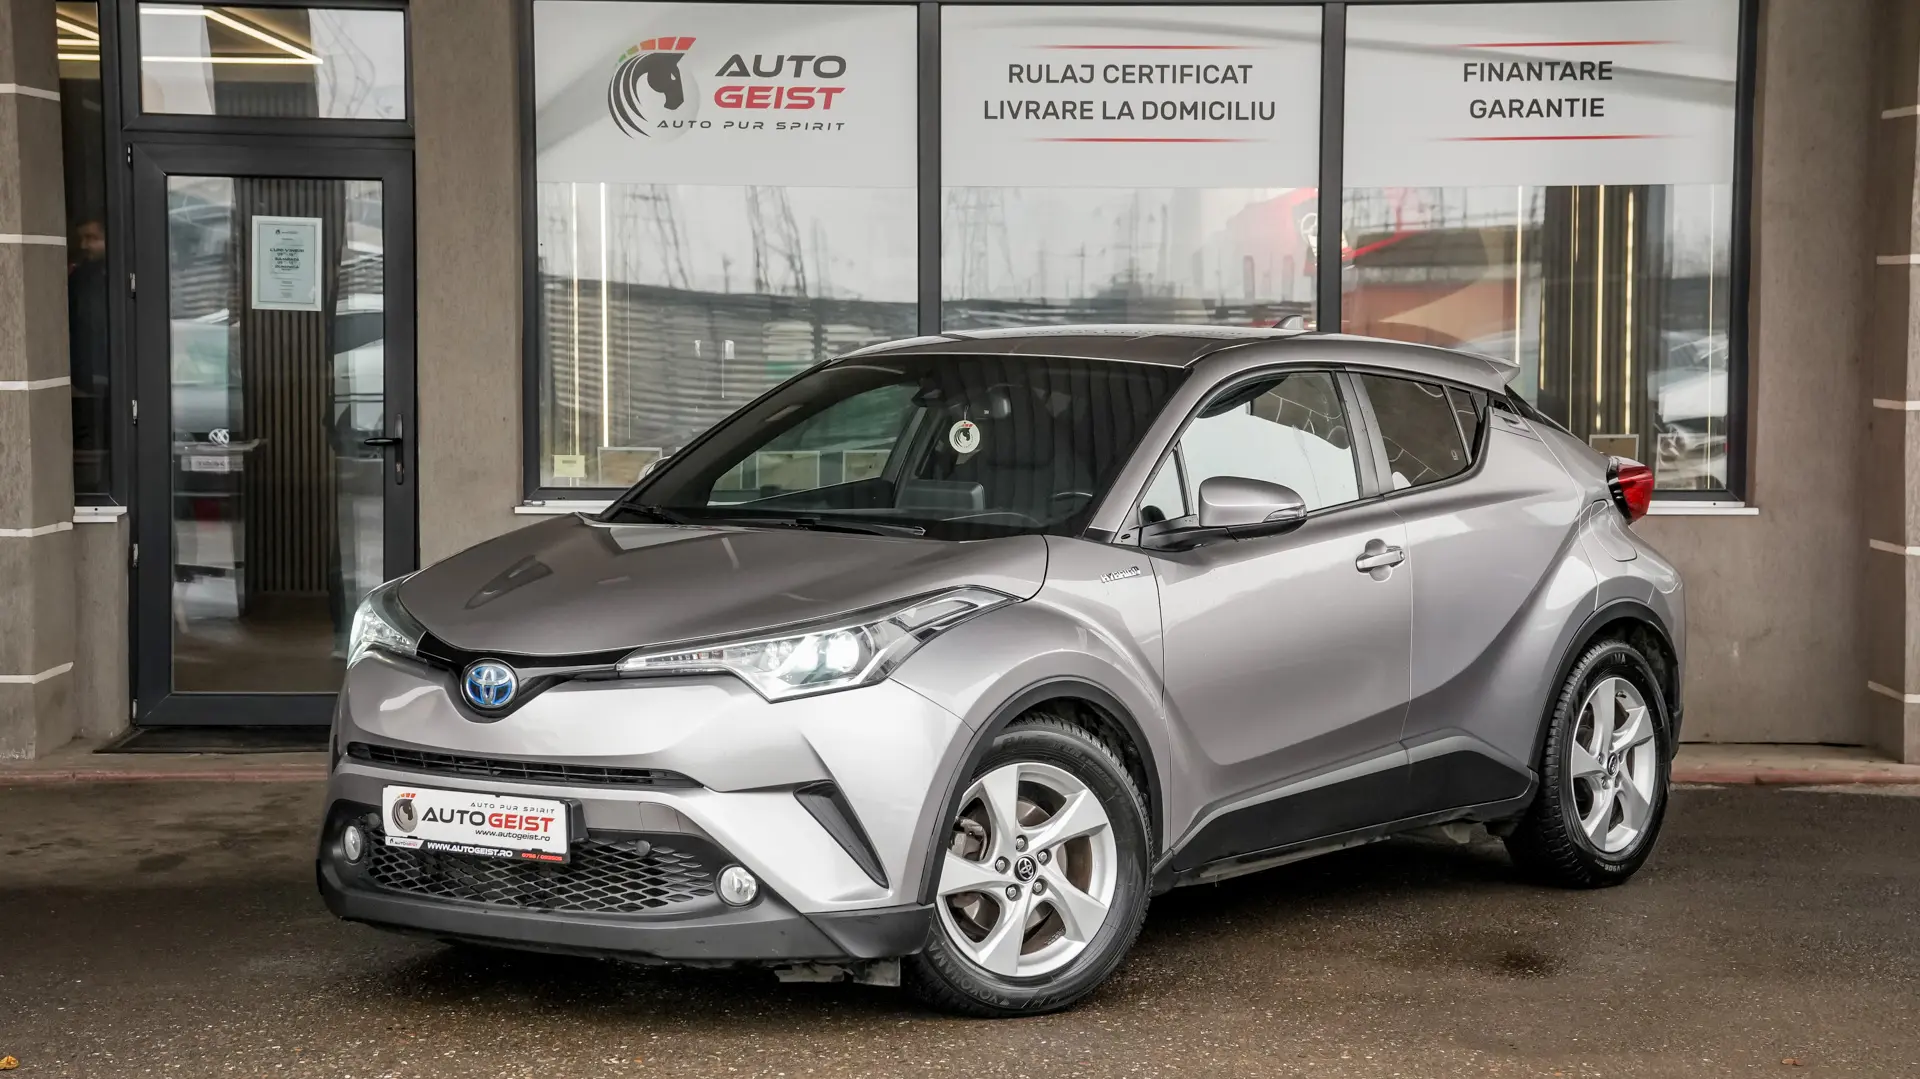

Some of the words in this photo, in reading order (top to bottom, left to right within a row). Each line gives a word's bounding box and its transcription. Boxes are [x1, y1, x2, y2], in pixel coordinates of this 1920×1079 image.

[715, 54, 847, 78] AUTO
[1008, 64, 1095, 84] RULAJ
[1102, 64, 1253, 84] CERTIFICAT
[1463, 61, 1613, 82] FINANTARE
[714, 85, 846, 110] GEIST
[984, 100, 1094, 120] LIVRARE
[1102, 100, 1135, 120] LA
[1141, 101, 1276, 121] DOMICILIU
[1469, 98, 1605, 119] GARANTIE
[657, 120, 712, 129] AUTO
[723, 120, 765, 130] PUR
[775, 121, 847, 131] SPIRIT
[523, 806, 555, 814] SPIRIT
[475, 829, 551, 842] www.autogeist.ro
[427, 842, 513, 857] WWW.AUTOGEIST.RO
